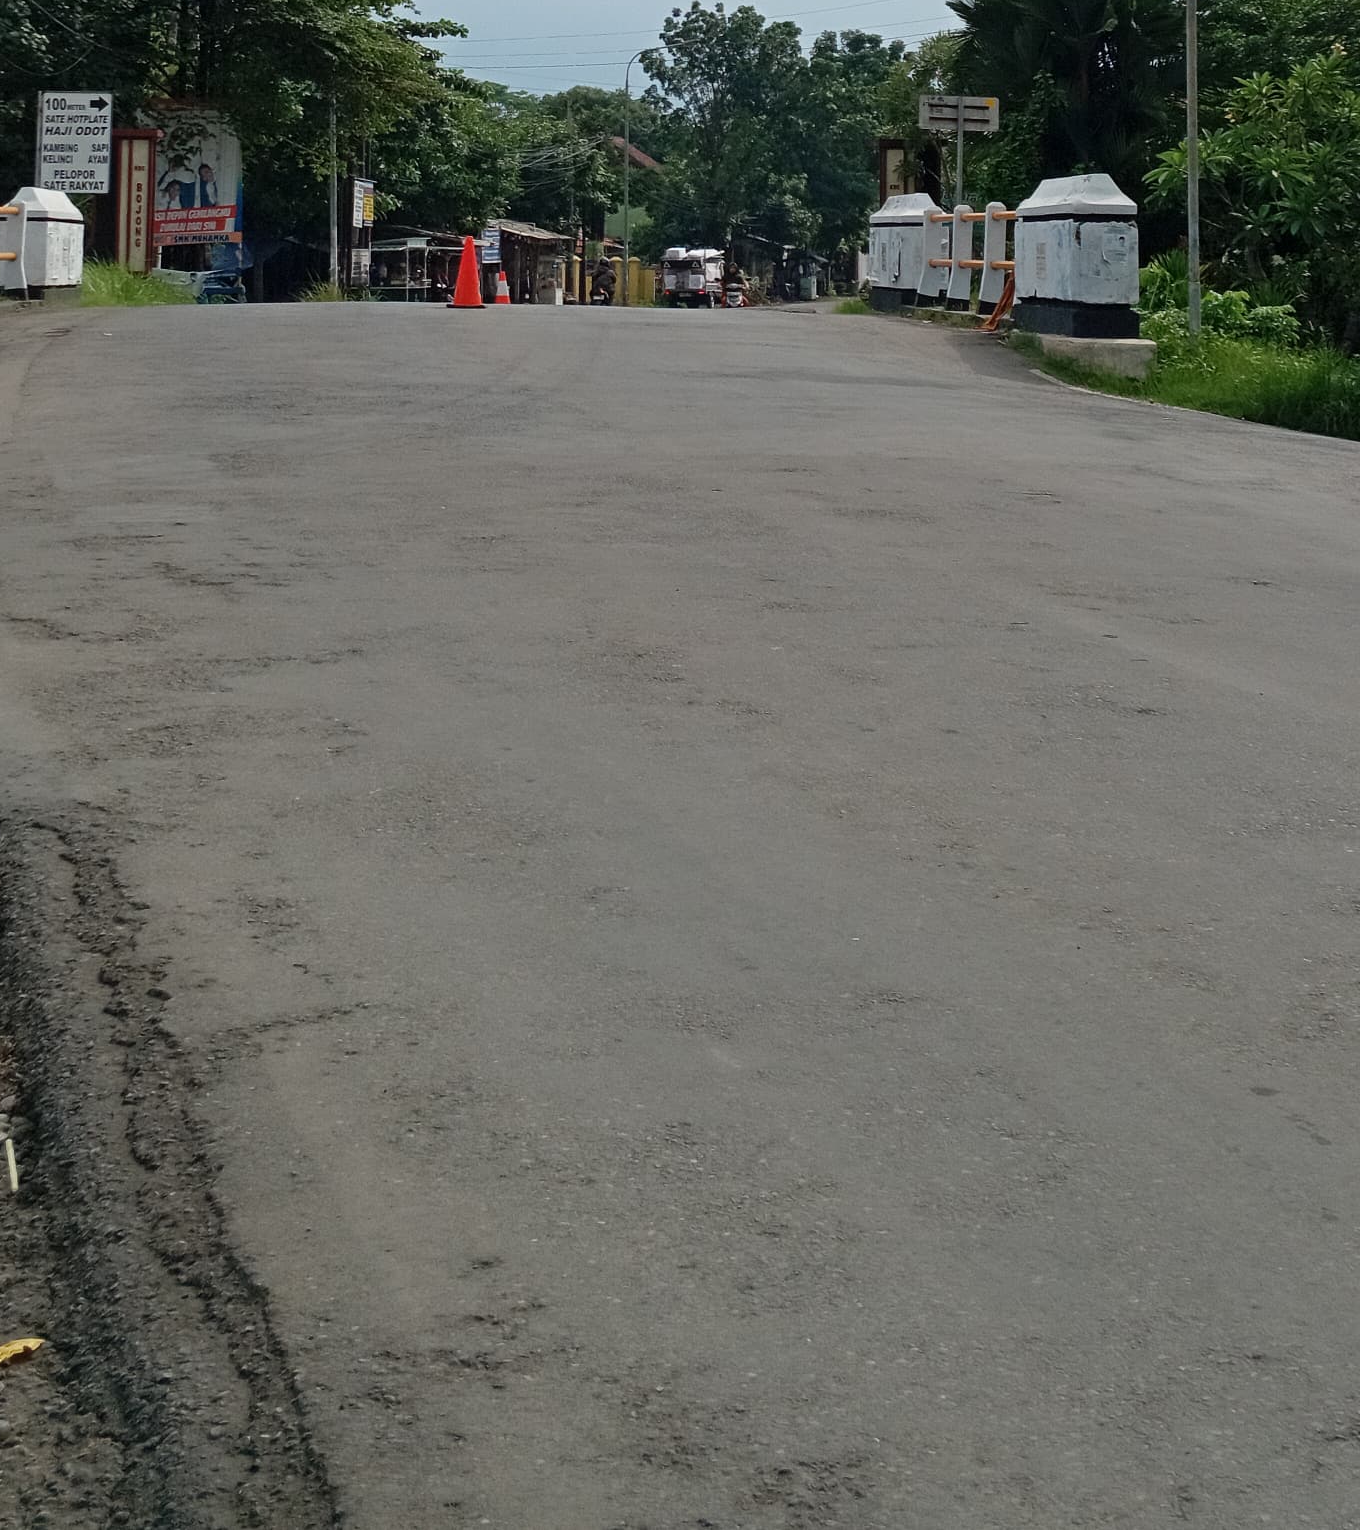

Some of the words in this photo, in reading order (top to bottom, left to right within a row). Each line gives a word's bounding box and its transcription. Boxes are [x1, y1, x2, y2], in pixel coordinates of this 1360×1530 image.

[45, 98, 67, 111] 100
[44, 115, 65, 123] SATE
[67, 115, 109, 124] HOTPLATE
[44, 126, 72, 136] HAJI
[75, 126, 108, 136] ODOT
[42, 143, 79, 152] KAMBING
[91, 144, 109, 152] SAPI
[42, 154, 73, 163] KELINCI
[88, 155, 108, 164] AYAM
[54, 170, 96, 179] PELOPOR
[44, 181, 64, 190] SATE
[69, 181, 105, 190] RAKYAT
[135, 182, 143, 248] BOJONG
[174, 235, 191, 243] SMK
